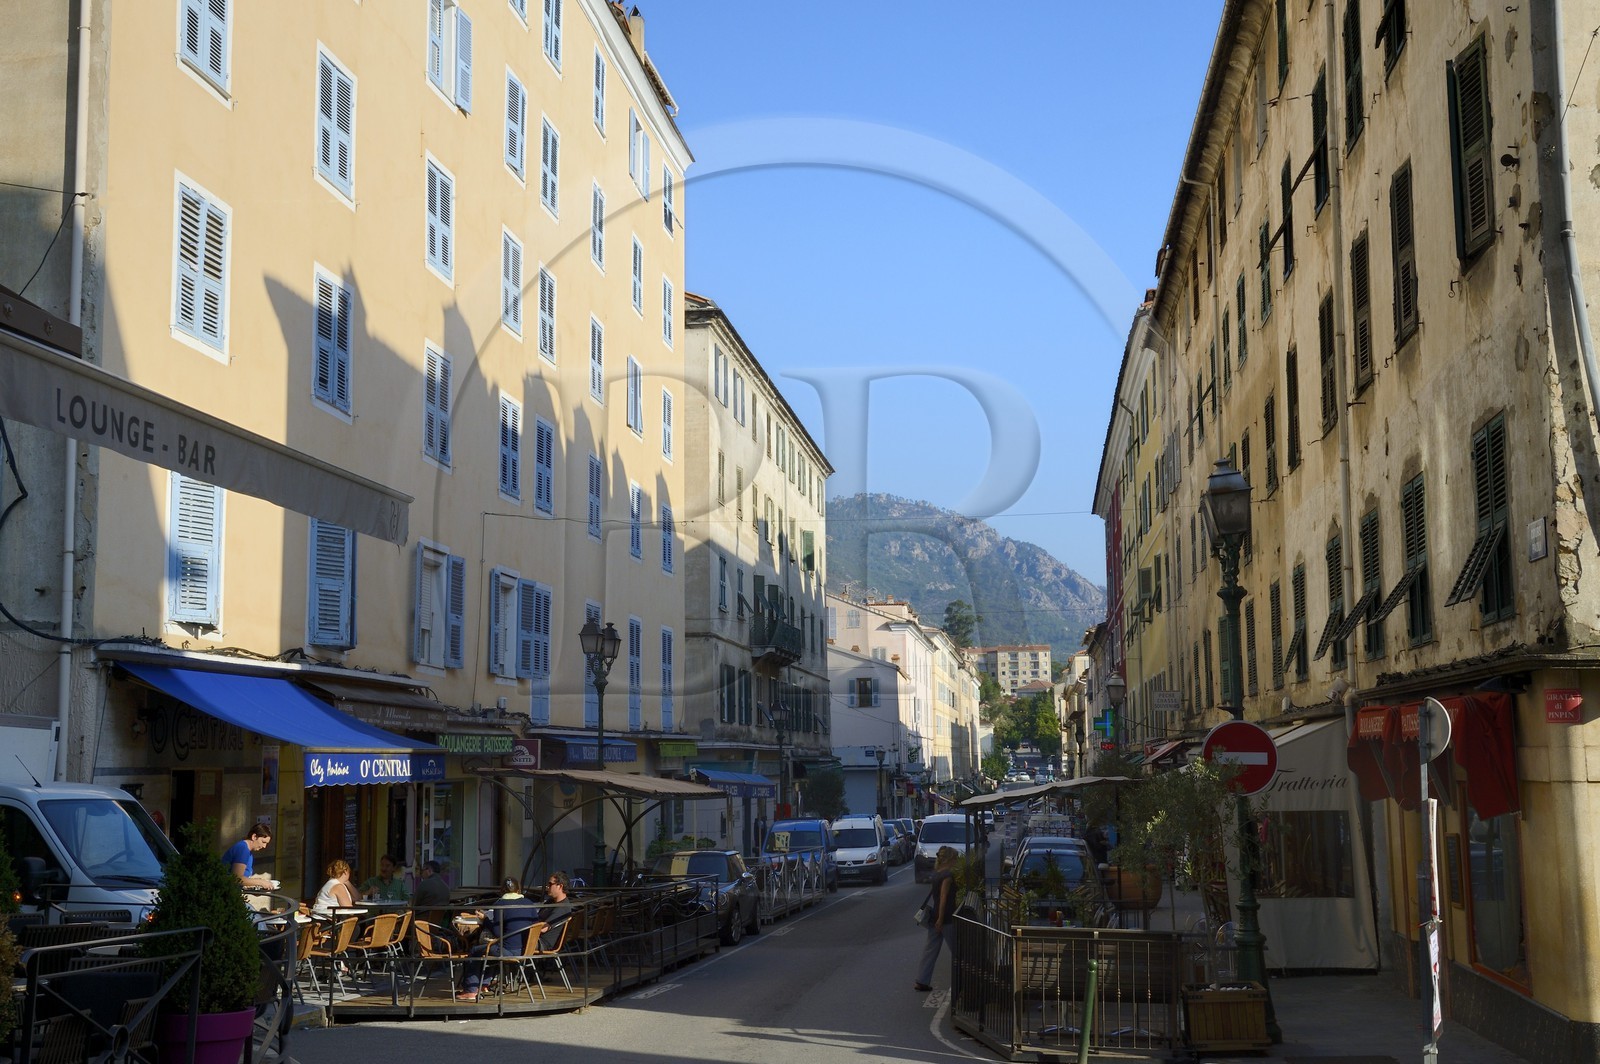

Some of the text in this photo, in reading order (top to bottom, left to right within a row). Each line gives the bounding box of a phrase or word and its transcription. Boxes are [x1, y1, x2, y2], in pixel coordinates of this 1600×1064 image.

[56, 387, 155, 454] LOUNGE
[178, 433, 217, 476] BAR
[438, 735, 482, 753] BOULANGERIE
[483, 736, 513, 753] PATISSERIE
[310, 758, 325, 783] Chez
[327, 758, 350, 777] Antoine
[360, 759, 371, 778] O'
[372, 759, 412, 777] CENTRAL
[1267, 767, 1347, 792] Trattoria
